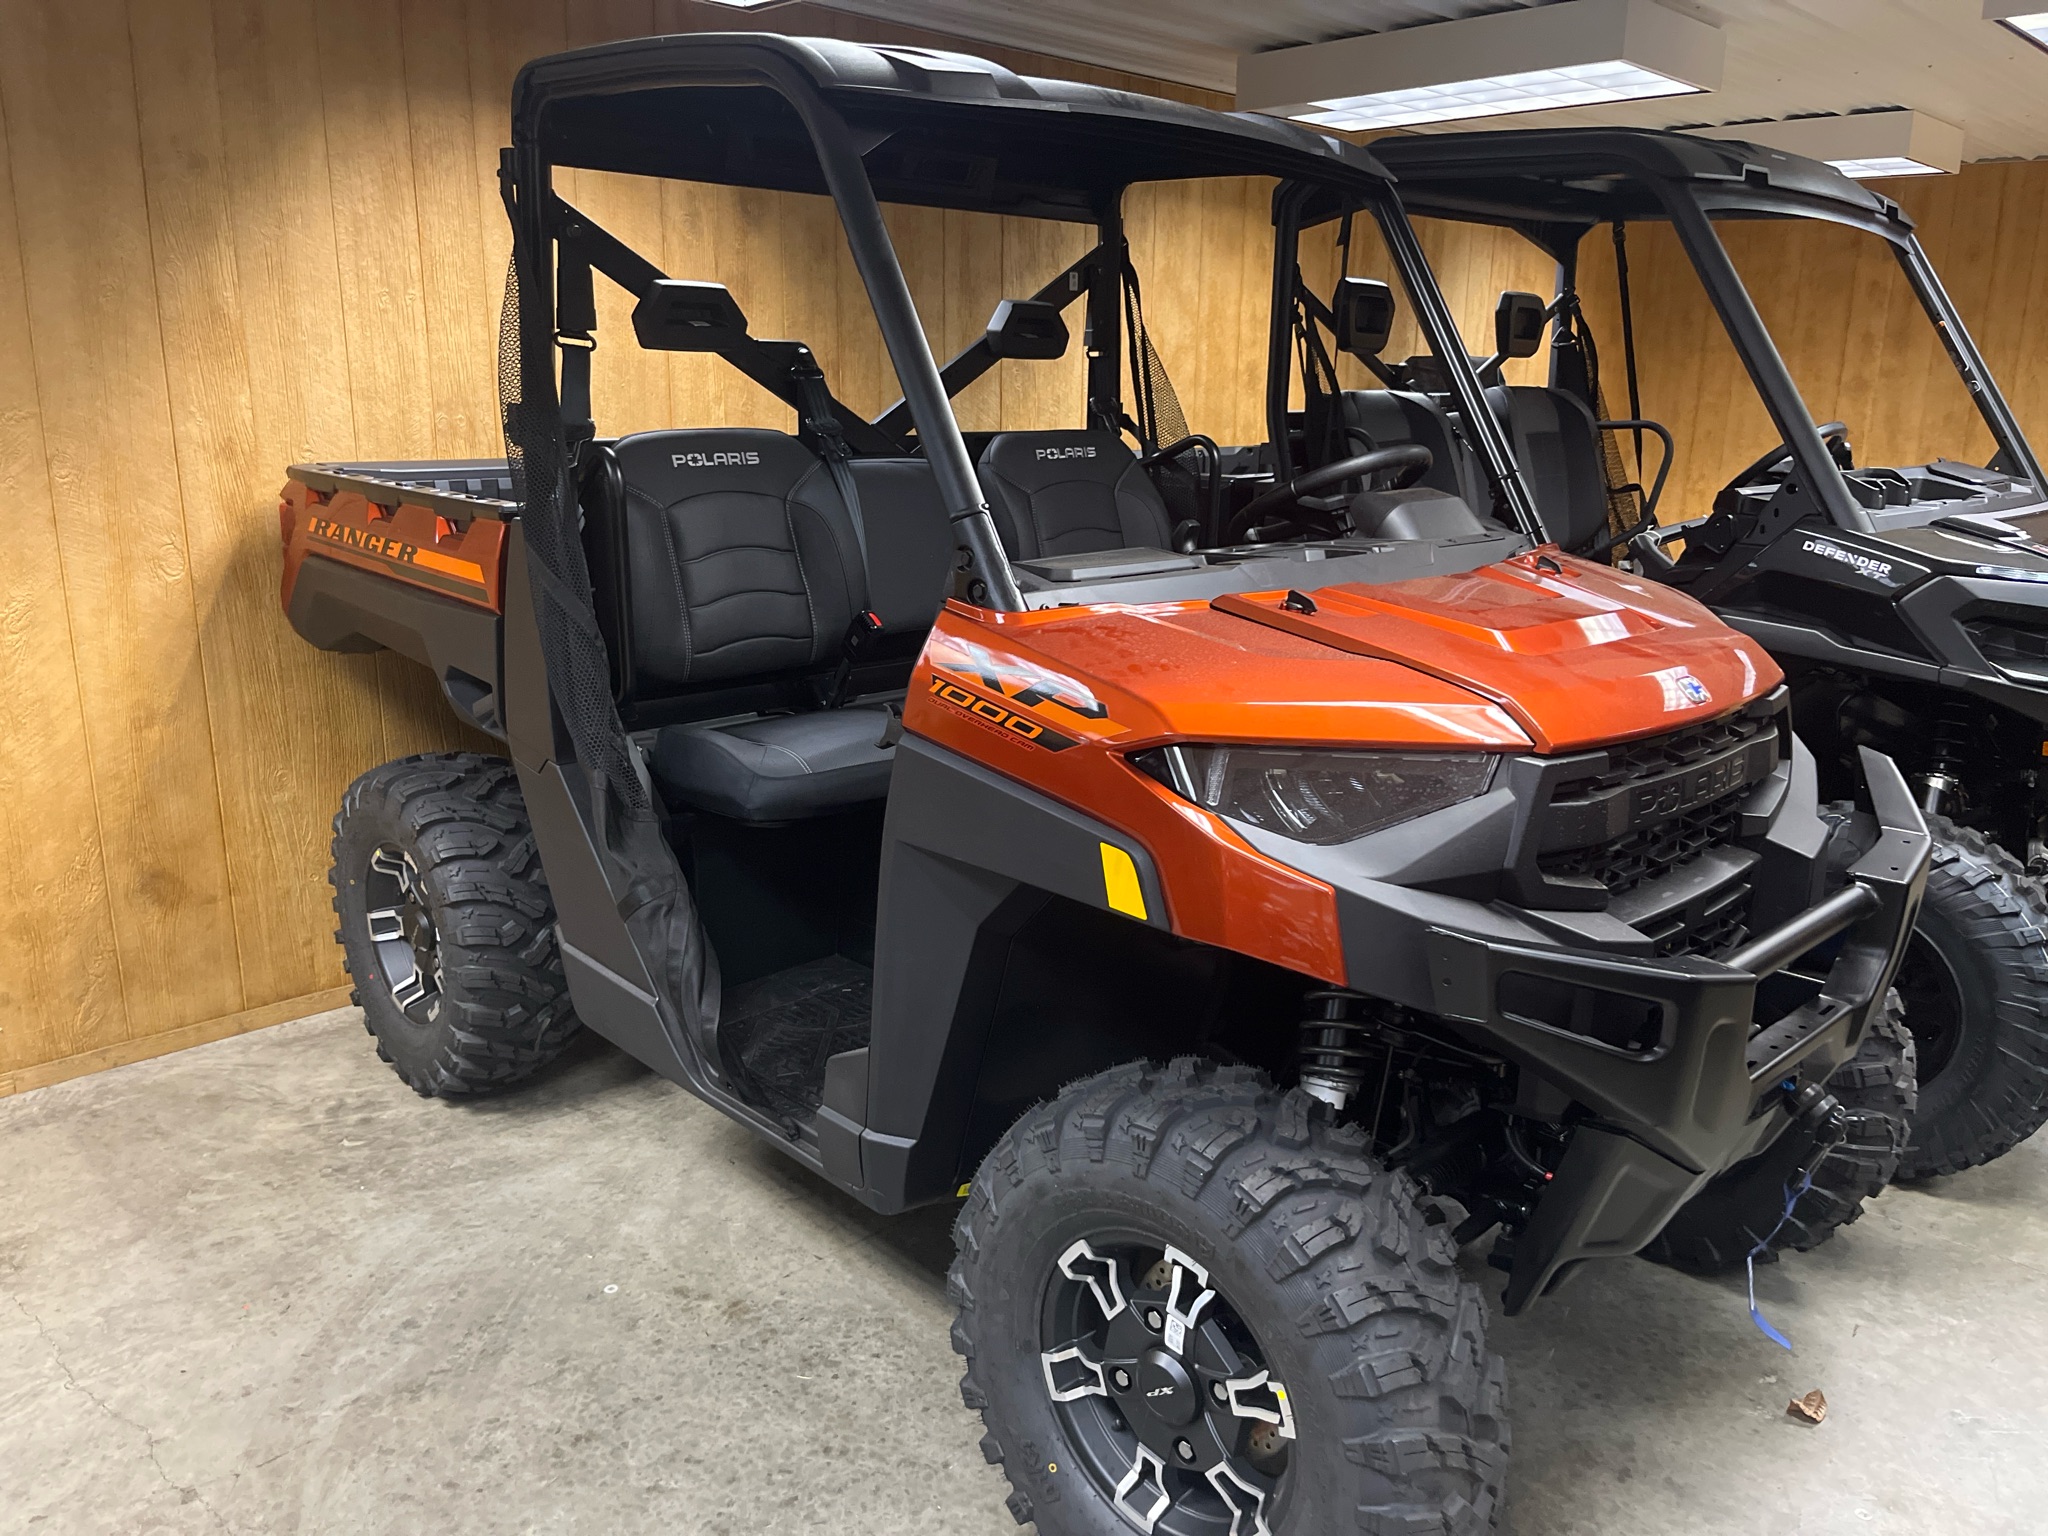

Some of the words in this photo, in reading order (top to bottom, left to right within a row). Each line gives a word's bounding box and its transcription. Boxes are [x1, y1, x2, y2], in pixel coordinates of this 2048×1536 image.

[671, 450, 761, 468] POLARIS
[1035, 445, 1097, 462] POLARIS
[314, 517, 418, 565] RANGER
[1802, 540, 1893, 575] DEFENDER
[935, 643, 1109, 720] XP
[927, 697, 954, 713] DUAL
[955, 710, 1010, 738] OVERHEAD
[1009, 736, 1035, 751] CAM
[928, 678, 1044, 740] 1000
[1634, 757, 1747, 824] POLARIS
[1146, 1386, 1174, 1397] XP
